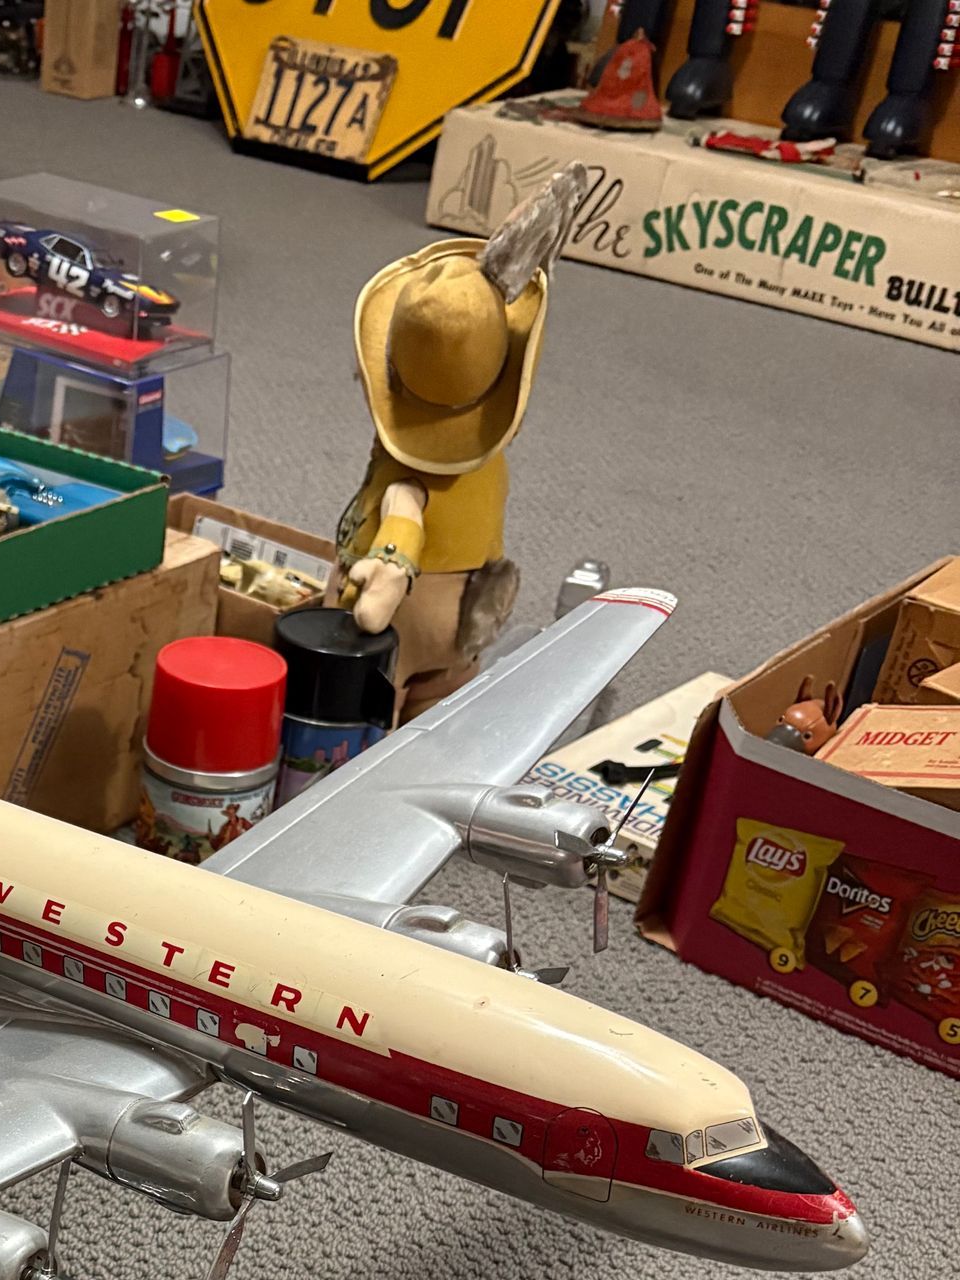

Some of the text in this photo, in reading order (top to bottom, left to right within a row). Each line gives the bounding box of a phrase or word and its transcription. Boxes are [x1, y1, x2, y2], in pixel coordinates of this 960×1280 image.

[642, 198, 888, 288] SKYSCRAPER
[885, 275, 960, 317] BUIL
[47, 255, 91, 298] 42
[855, 731, 958, 746] MIDGET
[534, 762, 667, 824] HASSIS
[747, 837, 804, 872] Lay's
[826, 876, 893, 913] Doritos
[776, 954, 789, 967] 9
[859, 987, 872, 1000] 7
[946, 1024, 960, 1038] 5
[685, 1206, 819, 1239] WESTERN AIRLINES
